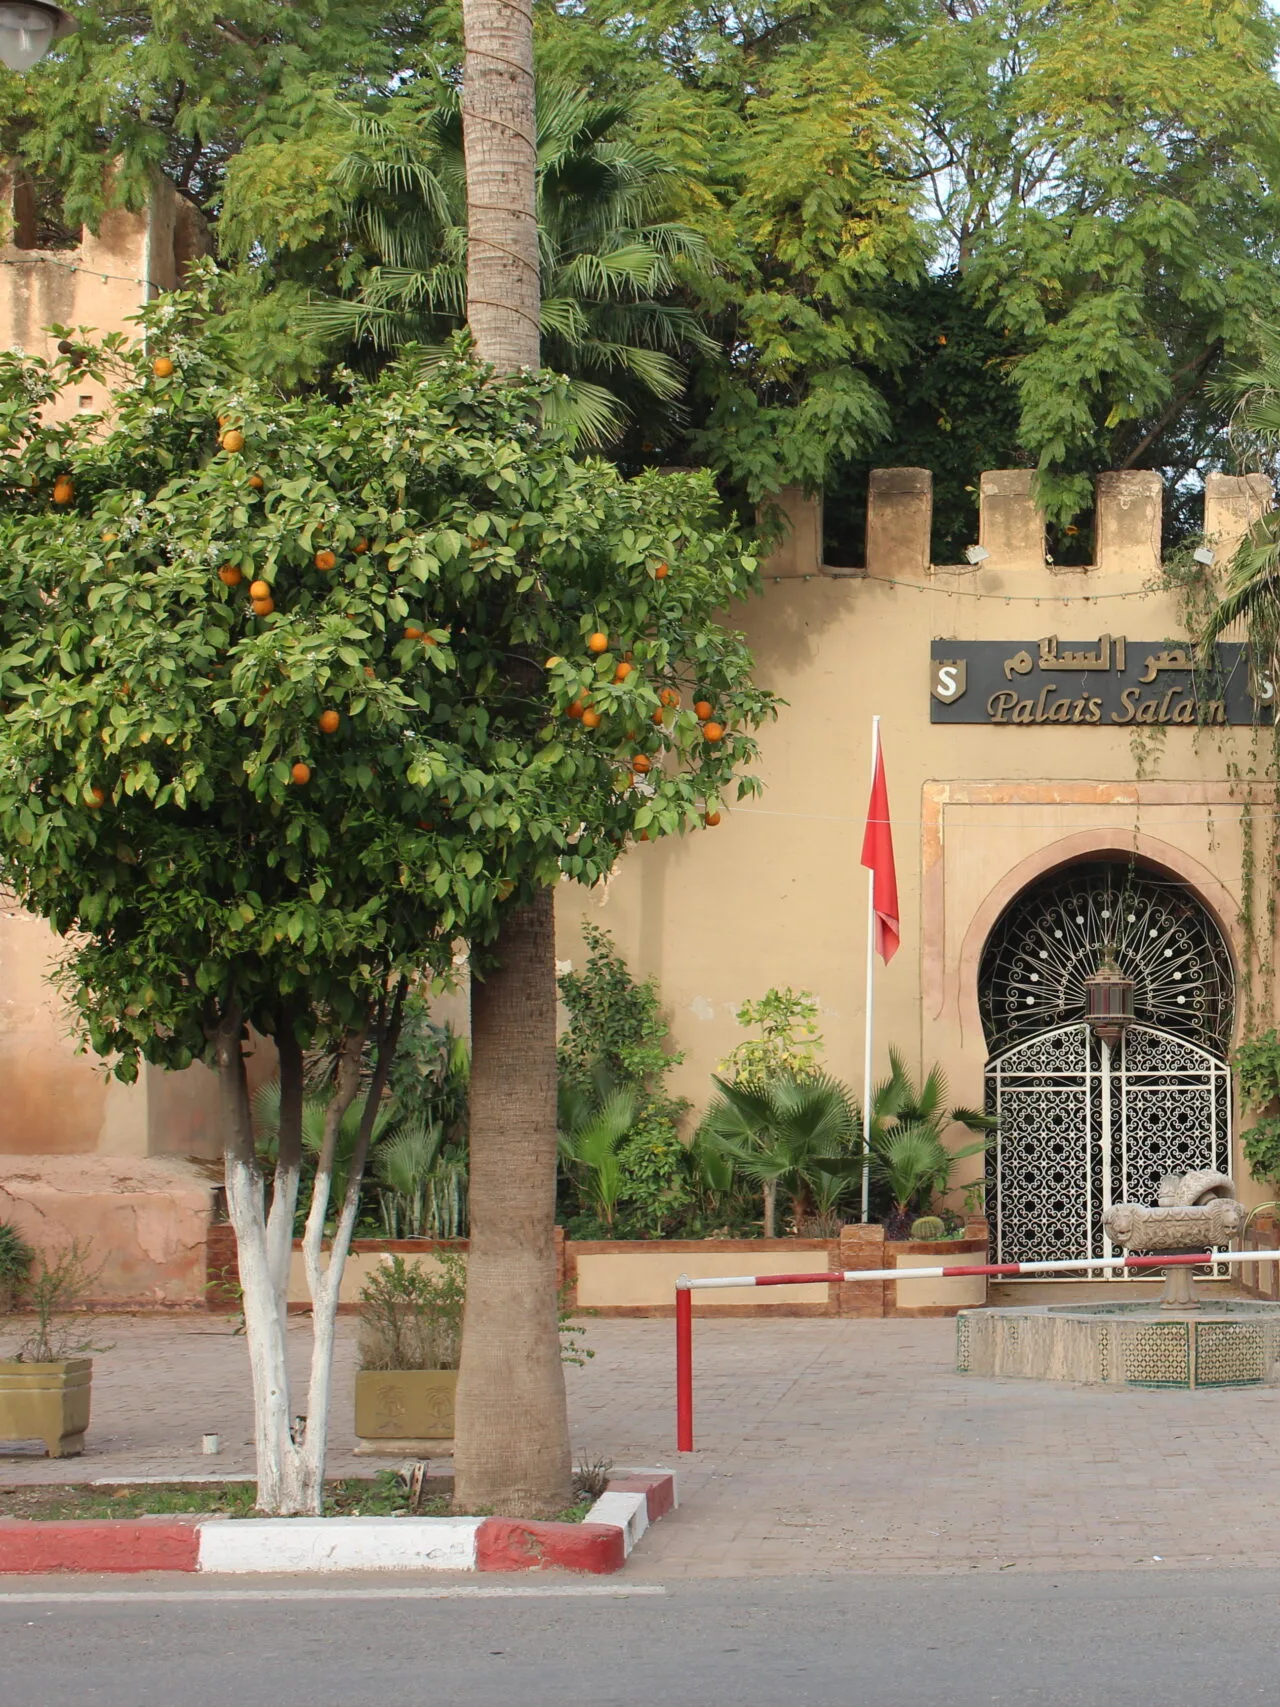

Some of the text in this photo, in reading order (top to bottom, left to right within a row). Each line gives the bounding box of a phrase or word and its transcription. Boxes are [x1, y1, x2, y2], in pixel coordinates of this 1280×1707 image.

[1003, 634, 1126, 680] السلام
[936, 666, 957, 696] S
[987, 684, 1103, 724] Palais
